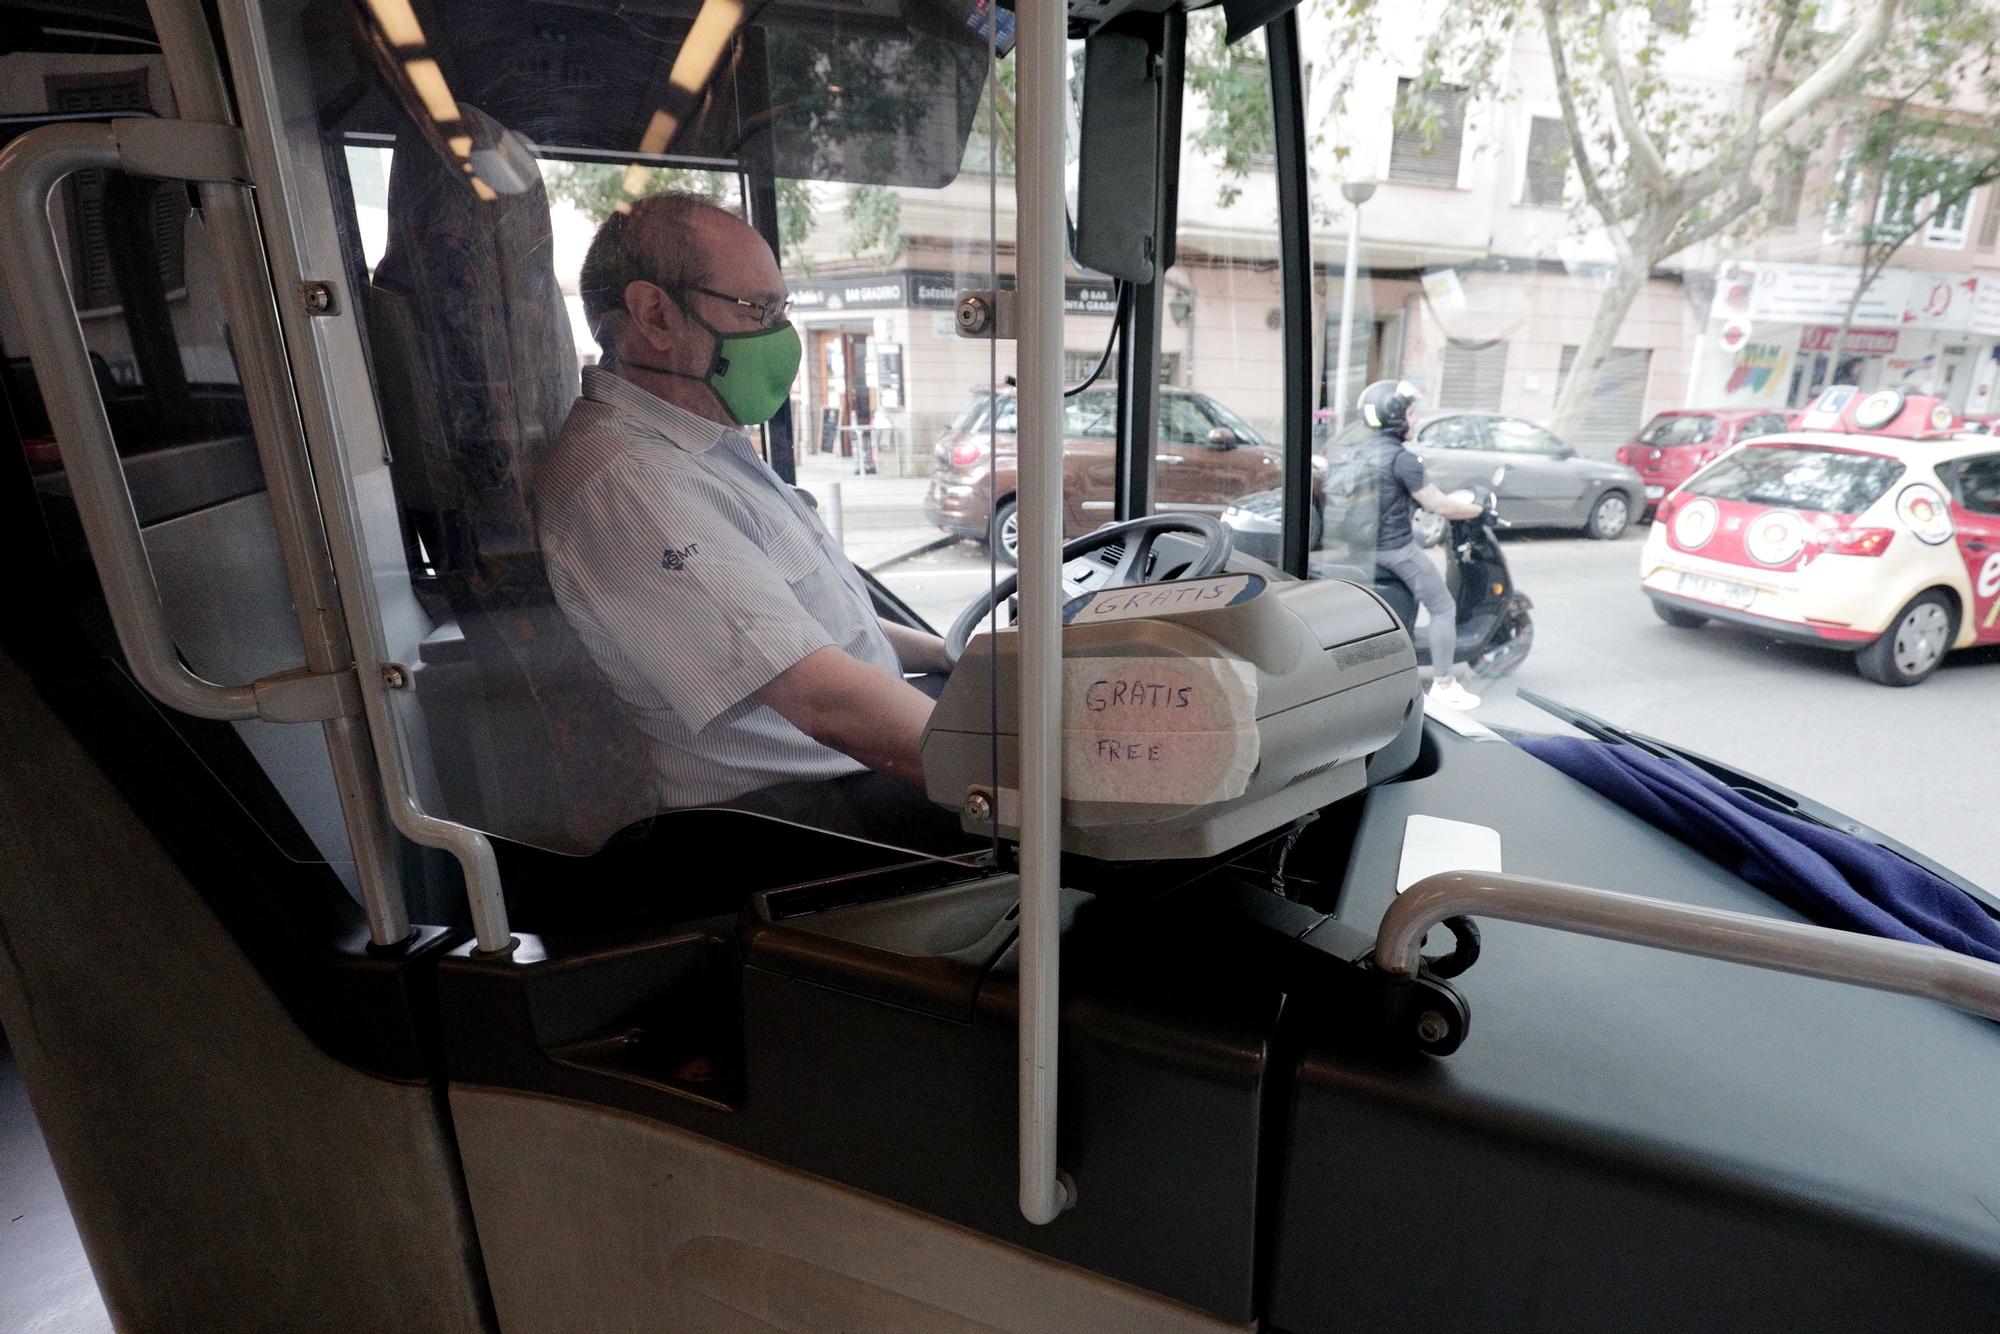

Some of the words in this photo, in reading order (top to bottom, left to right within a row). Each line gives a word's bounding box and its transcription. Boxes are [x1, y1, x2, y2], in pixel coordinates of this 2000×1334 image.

[845, 288, 860, 303] BAR
[1094, 584, 1228, 614] GRATIS
[1086, 680, 1192, 712] GRATIS
[1096, 739, 1164, 761] FREE
